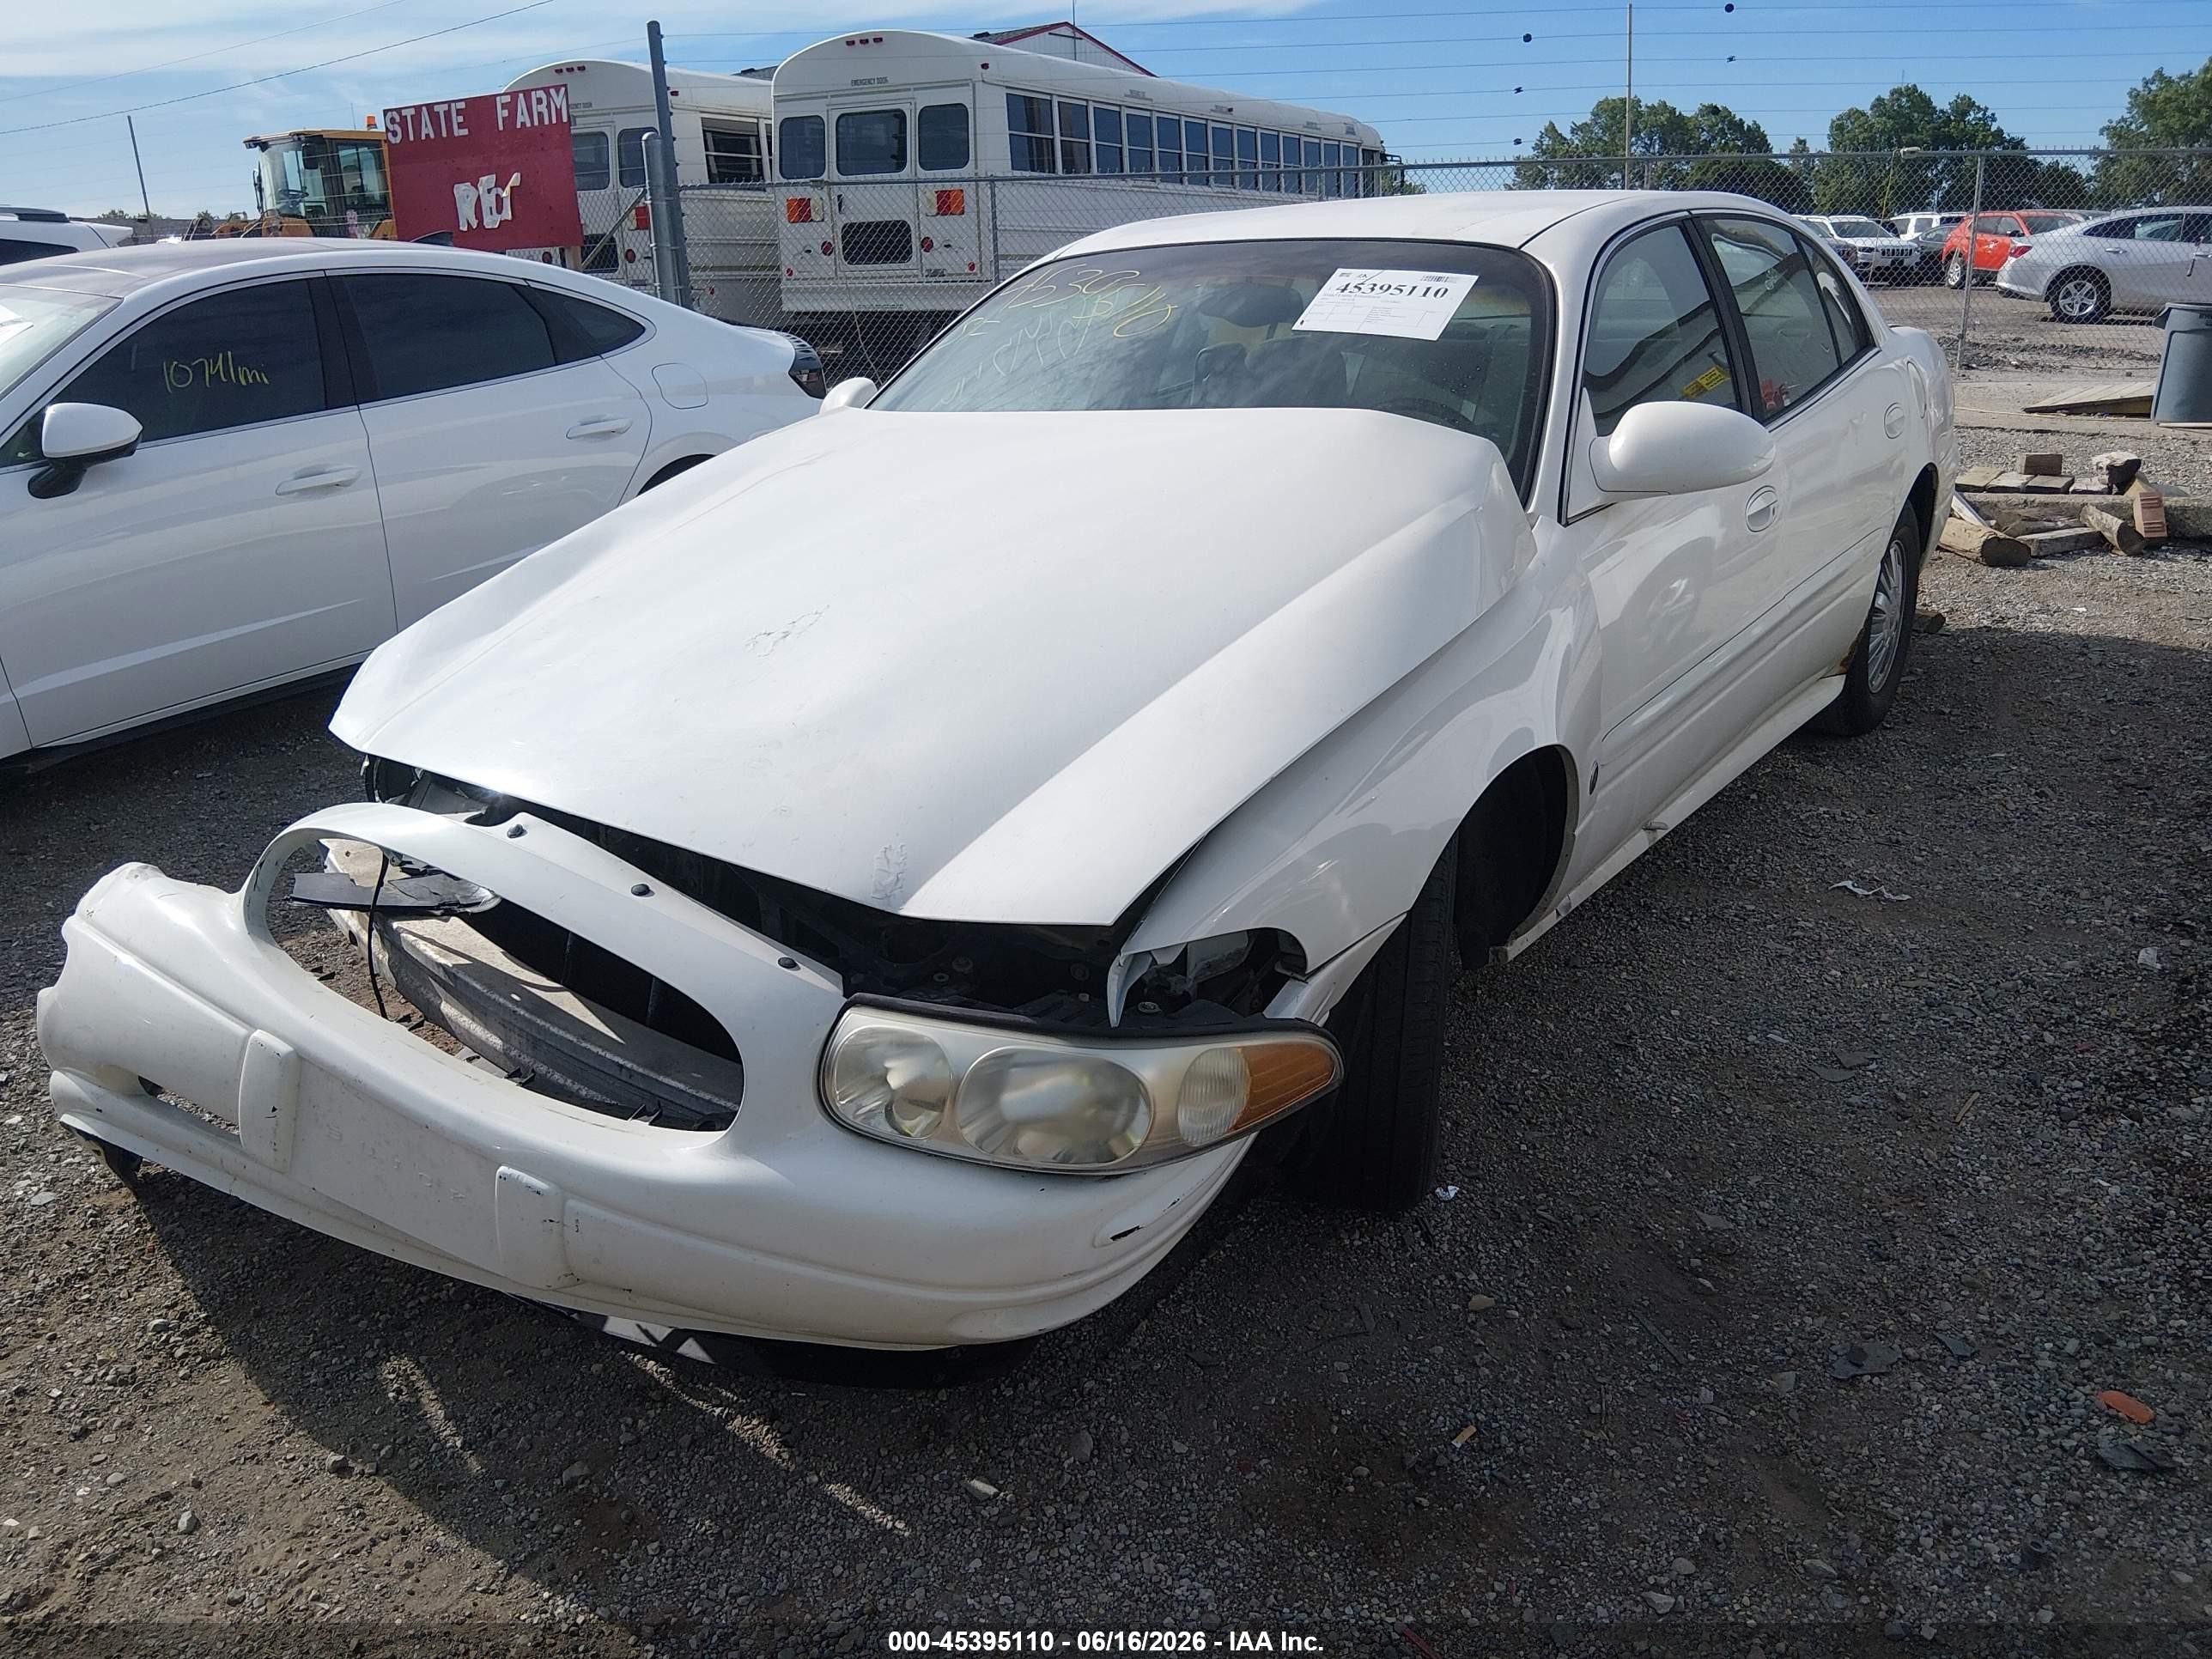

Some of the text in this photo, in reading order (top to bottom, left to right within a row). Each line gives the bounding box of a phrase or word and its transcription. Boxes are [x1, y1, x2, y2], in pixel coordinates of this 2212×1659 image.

[386, 87, 568, 144] STATE FARM
[1336, 283, 1449, 299] 45395110
